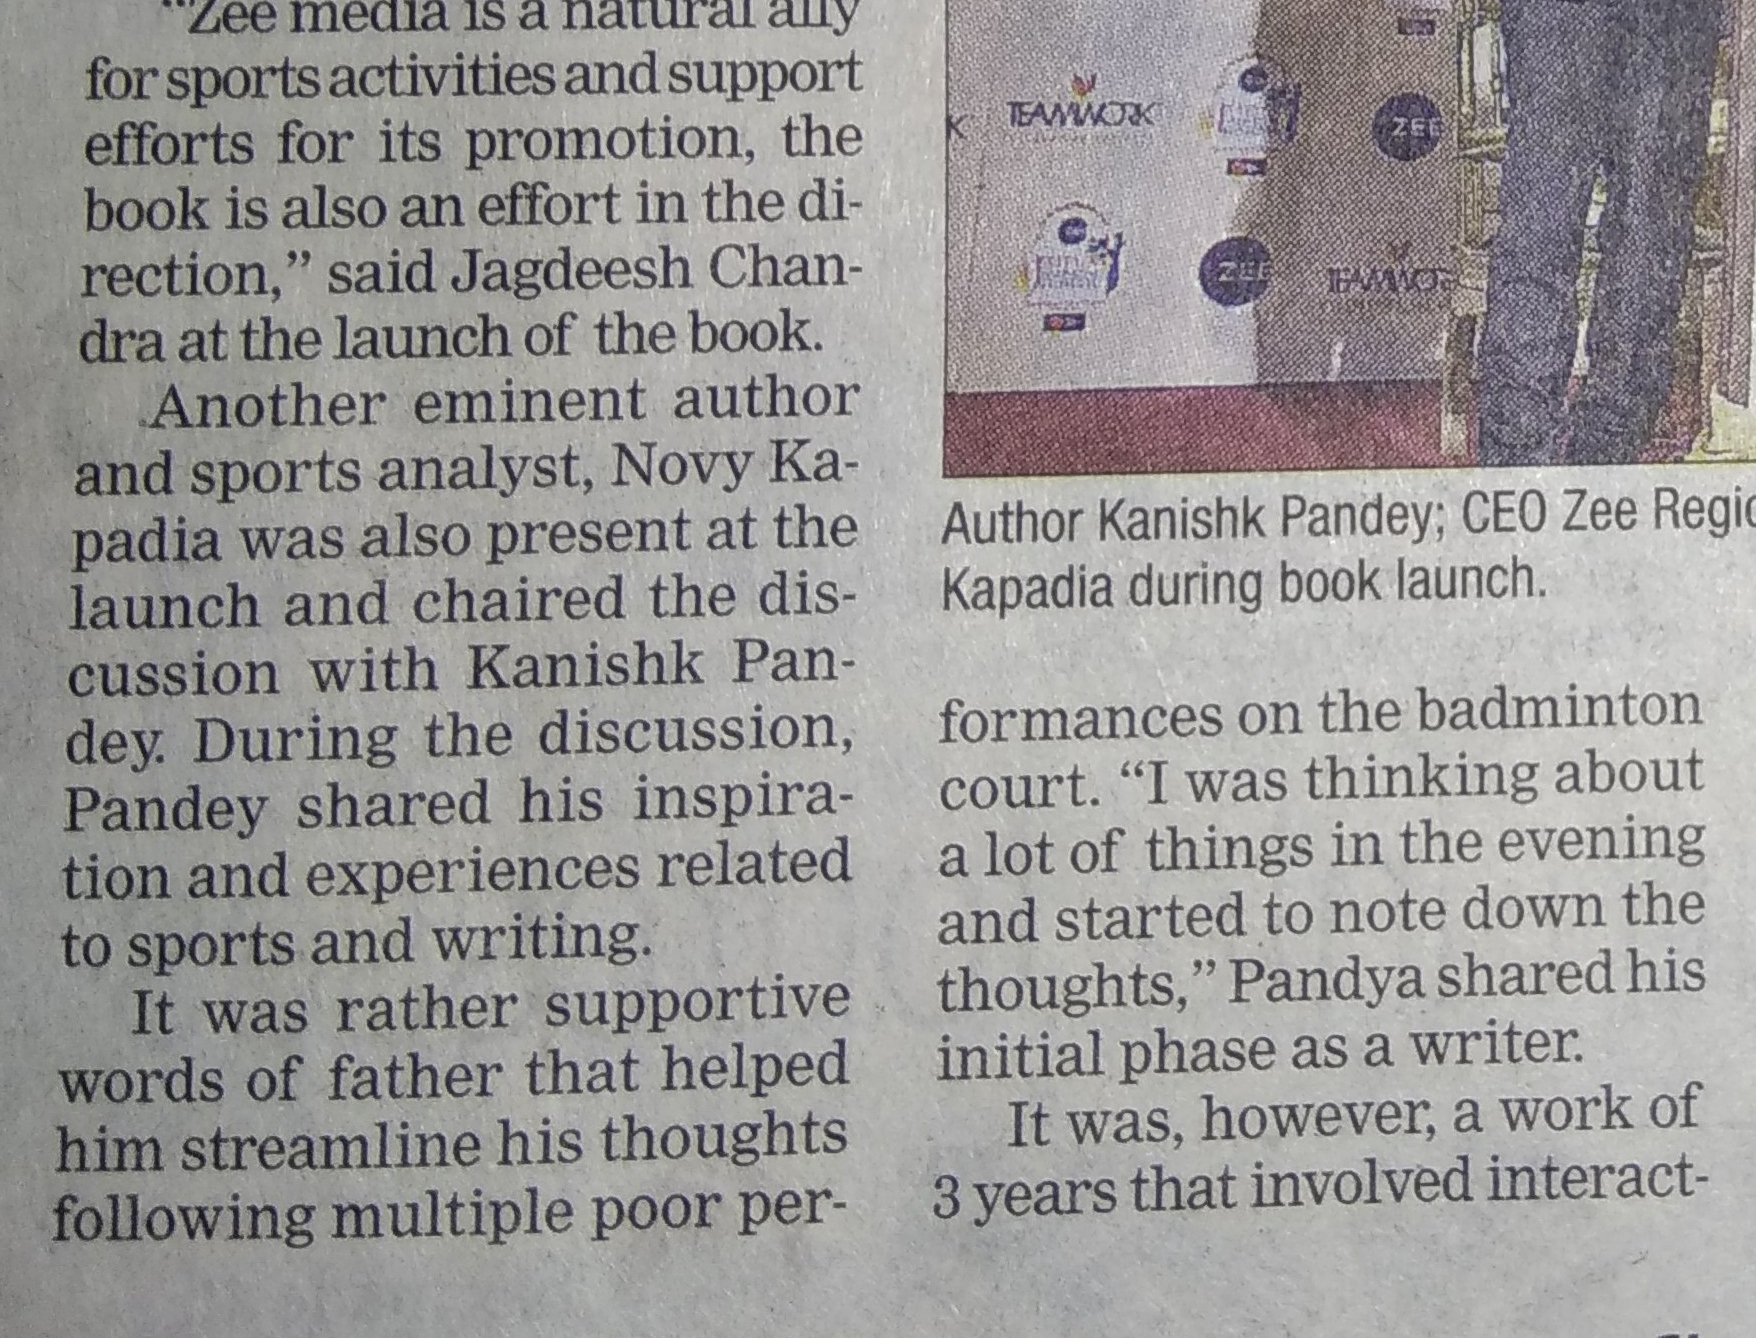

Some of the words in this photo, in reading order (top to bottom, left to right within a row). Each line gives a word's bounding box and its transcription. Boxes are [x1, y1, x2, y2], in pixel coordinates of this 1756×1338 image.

[84, 120, 254, 167] efforts
[277, 118, 355, 164] for
[379, 118, 442, 163] its
[465, 114, 755, 171] promotion,
[780, 112, 863, 158] the
[1006, 100, 1162, 127] TEAMWORK
[1391, 116, 1442, 138] ZEE
[80, 250, 311, 303] rection,”
[328, 247, 437, 294] said
[450, 244, 694, 301] Jagdeesh
[709, 242, 863, 289] Chan-
[1218, 261, 1269, 283] ZEE
[74, 449, 174, 497] and
[190, 449, 361, 504] sports
[378, 444, 594, 499] analyst,
[611, 441, 755, 494] Novy
[769, 438, 859, 483] Ka-
[941, 500, 1084, 545] Author
[1099, 496, 1266, 541] Kanishk
[1282, 493, 1444, 545] Pandey;
[1462, 489, 1547, 534] CEO
[1562, 488, 1637, 531] Zee
[69, 581, 262, 631] launch
[284, 578, 390, 627] and
[413, 573, 626, 624] chaired
[648, 572, 736, 619] the
[759, 569, 856, 616] dis-
[943, 564, 1114, 620] Kapadia
[1129, 561, 1262, 614] during
[1280, 558, 1382, 603] book
[1397, 554, 1546, 600] launch.
[66, 718, 165, 774] dey.
[193, 714, 398, 769] During
[424, 711, 513, 758] the
[538, 703, 852, 756] discussion,
[940, 764, 1100, 811] court.
[1120, 760, 1168, 805] “I
[1184, 768, 1288, 803] was
[1304, 751, 1540, 805] thinking
[1555, 748, 1704, 794] about
[61, 853, 172, 901] tion
[187, 850, 290, 899] and
[306, 845, 640, 905] experiences
[657, 835, 853, 888] related
[938, 896, 1040, 945] and
[1055, 890, 1247, 942] started
[1263, 892, 1314, 936] to
[1329, 888, 1447, 934] note
[1463, 884, 1606, 930] down
[1621, 880, 1705, 926] the
[57, 1055, 224, 1104] words
[246, 1054, 304, 1102] of
[328, 1051, 504, 1101] father
[525, 1048, 640, 1096] that
[661, 1037, 850, 1098] helped
[937, 1029, 1105, 1081] initial
[1119, 1027, 1276, 1085] phase
[1291, 1034, 1348, 1070] as
[1364, 1033, 1395, 1068] a
[1409, 1018, 1583, 1066] writer.
